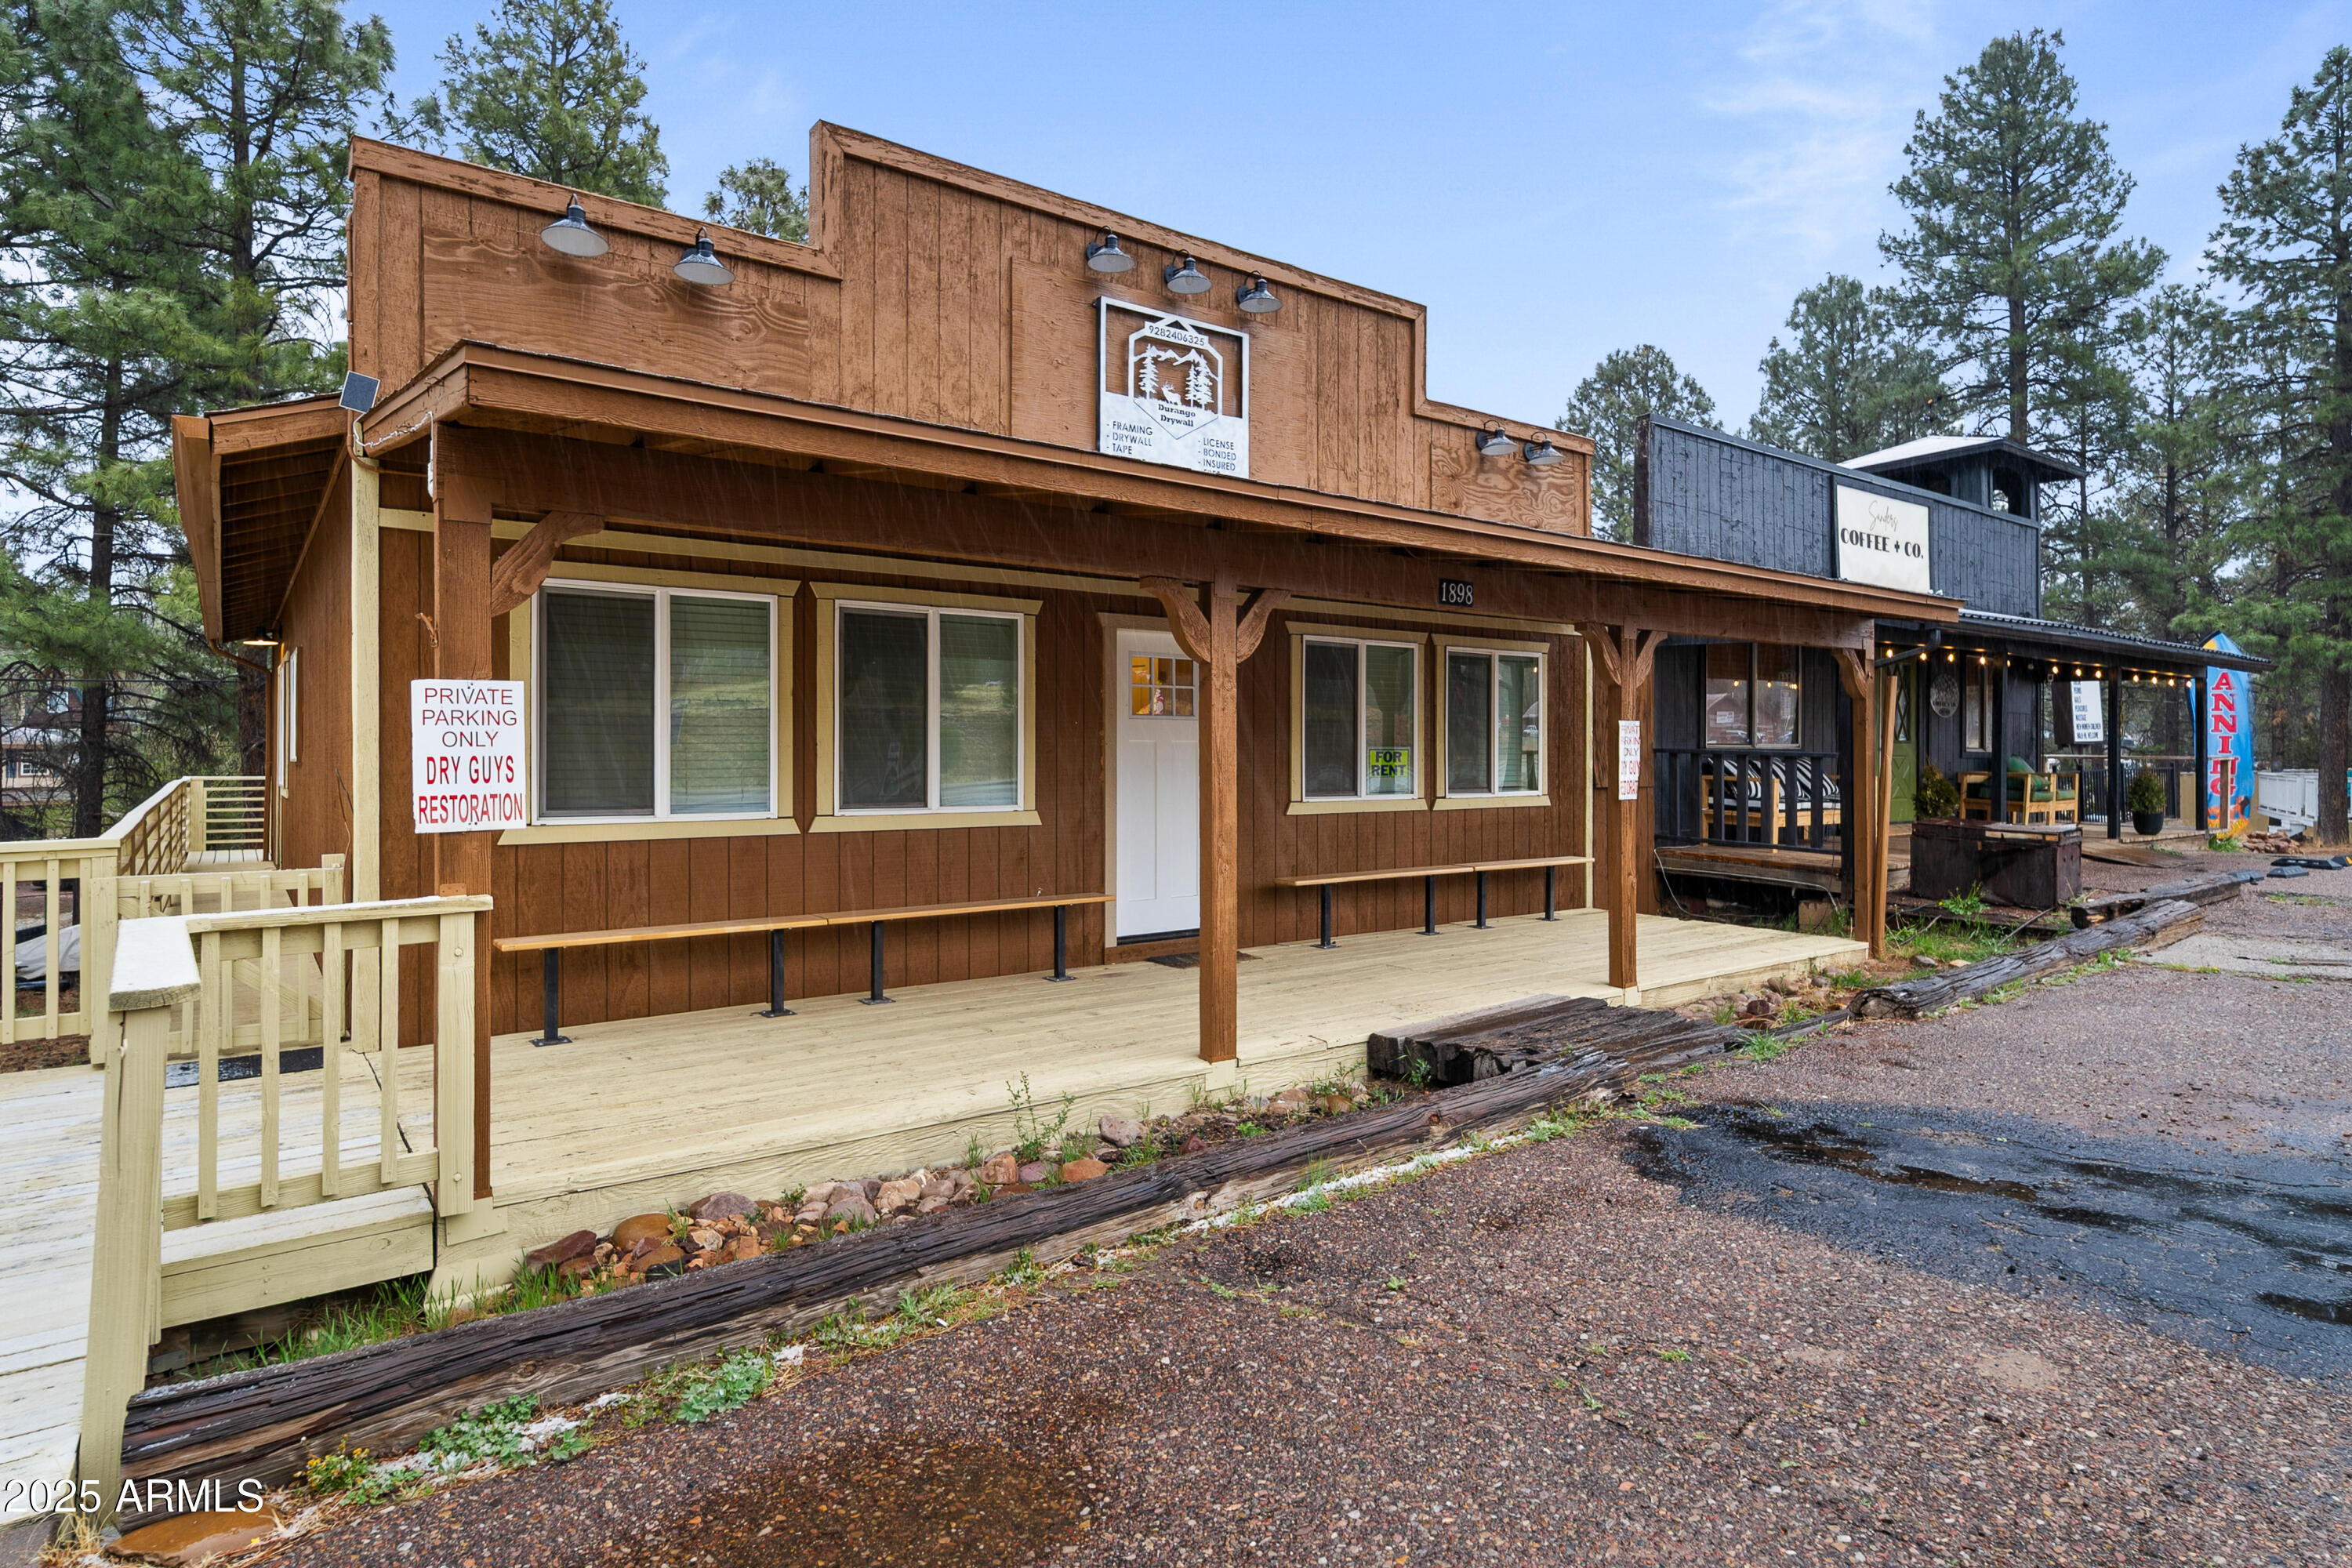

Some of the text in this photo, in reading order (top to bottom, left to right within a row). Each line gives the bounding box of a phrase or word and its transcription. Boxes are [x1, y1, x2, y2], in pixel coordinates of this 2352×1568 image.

[1149, 325, 1205, 347] 9282406325
[1158, 404, 1196, 418] Durango
[1112, 420, 1153, 436] FRAMING
[1160, 414, 1193, 427] Drywall
[1112, 432, 1152, 447] DRYWALL
[1203, 437, 1234, 451] LICENSE
[1112, 443, 1133, 455] TAPE
[1203, 448, 1236, 461] BONDED
[1203, 458, 1236, 471] INSURED
[1841, 528, 1890, 553] COFFEE
[1904, 541, 1924, 559] CO.
[1442, 582, 1473, 604] 1898
[424, 688, 513, 705] PRIVATE
[423, 710, 517, 726] PARKING
[441, 731, 499, 748] ONLY
[1375, 751, 1403, 763] FOR
[426, 755, 514, 785] DRY GUYS
[1371, 764, 1406, 776] RENT
[419, 793, 523, 824] RESTORATION
